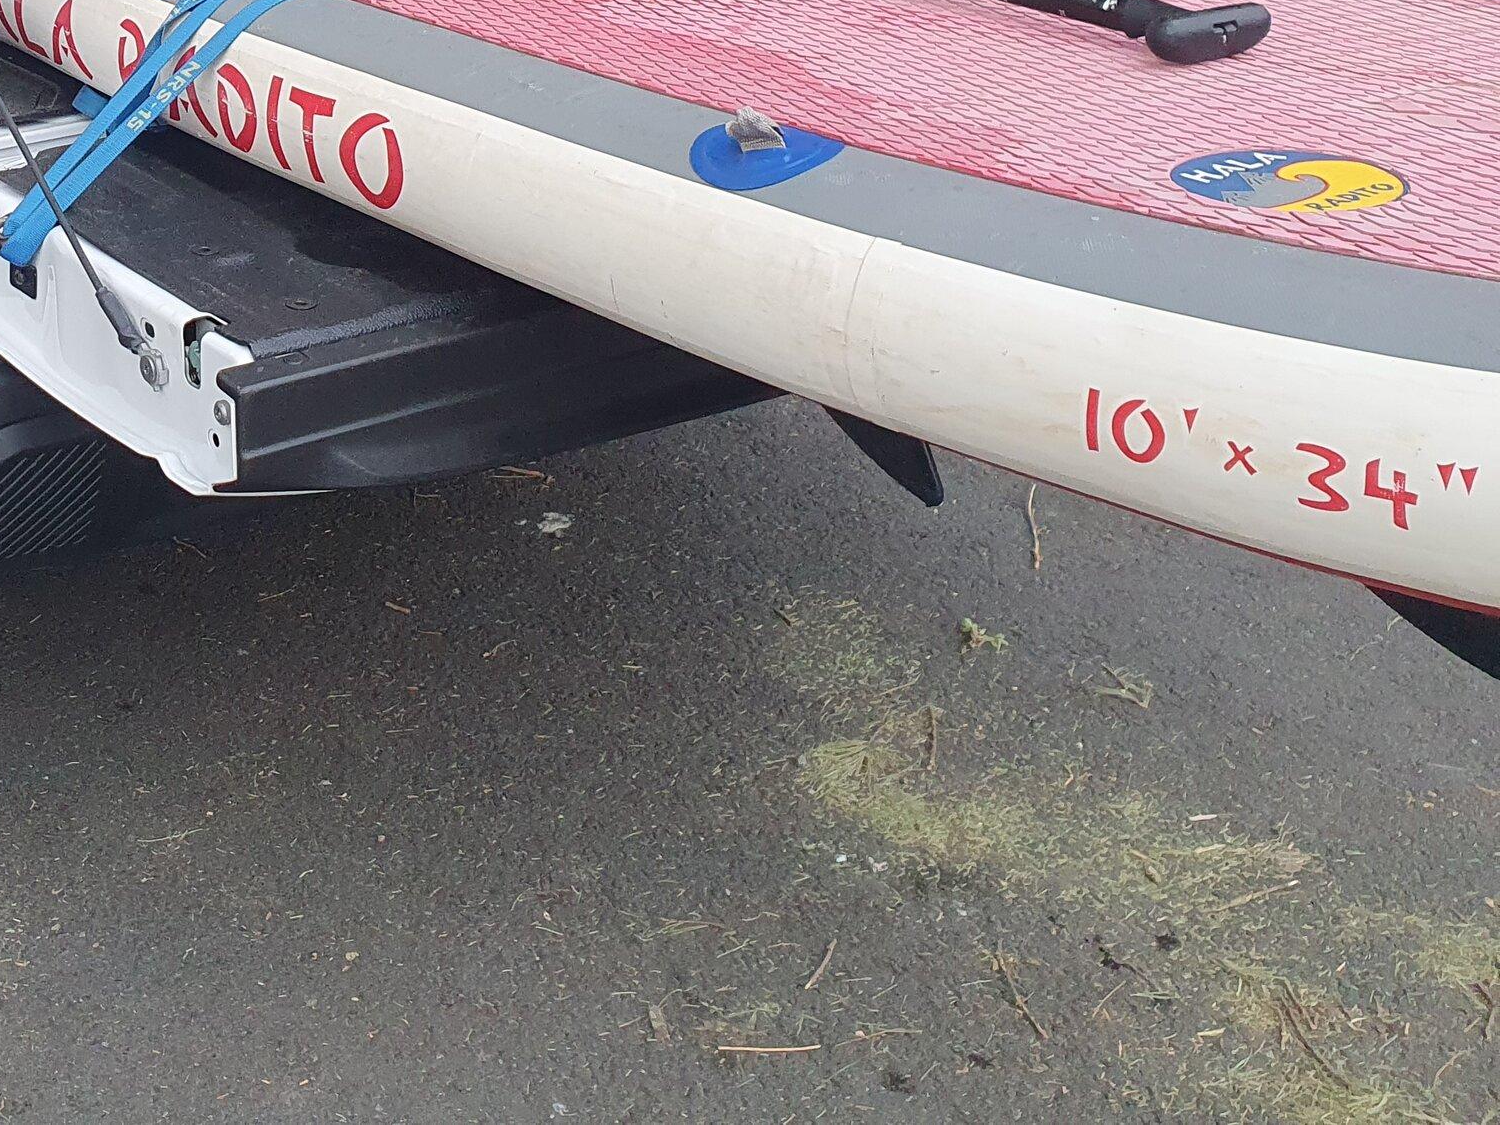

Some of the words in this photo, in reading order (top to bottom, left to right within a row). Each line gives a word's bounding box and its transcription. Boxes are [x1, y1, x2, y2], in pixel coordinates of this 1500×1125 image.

[126, 59, 202, 133] NRS-15
[1180, 151, 1288, 184] HALA
[1304, 182, 1395, 212] RADITO
